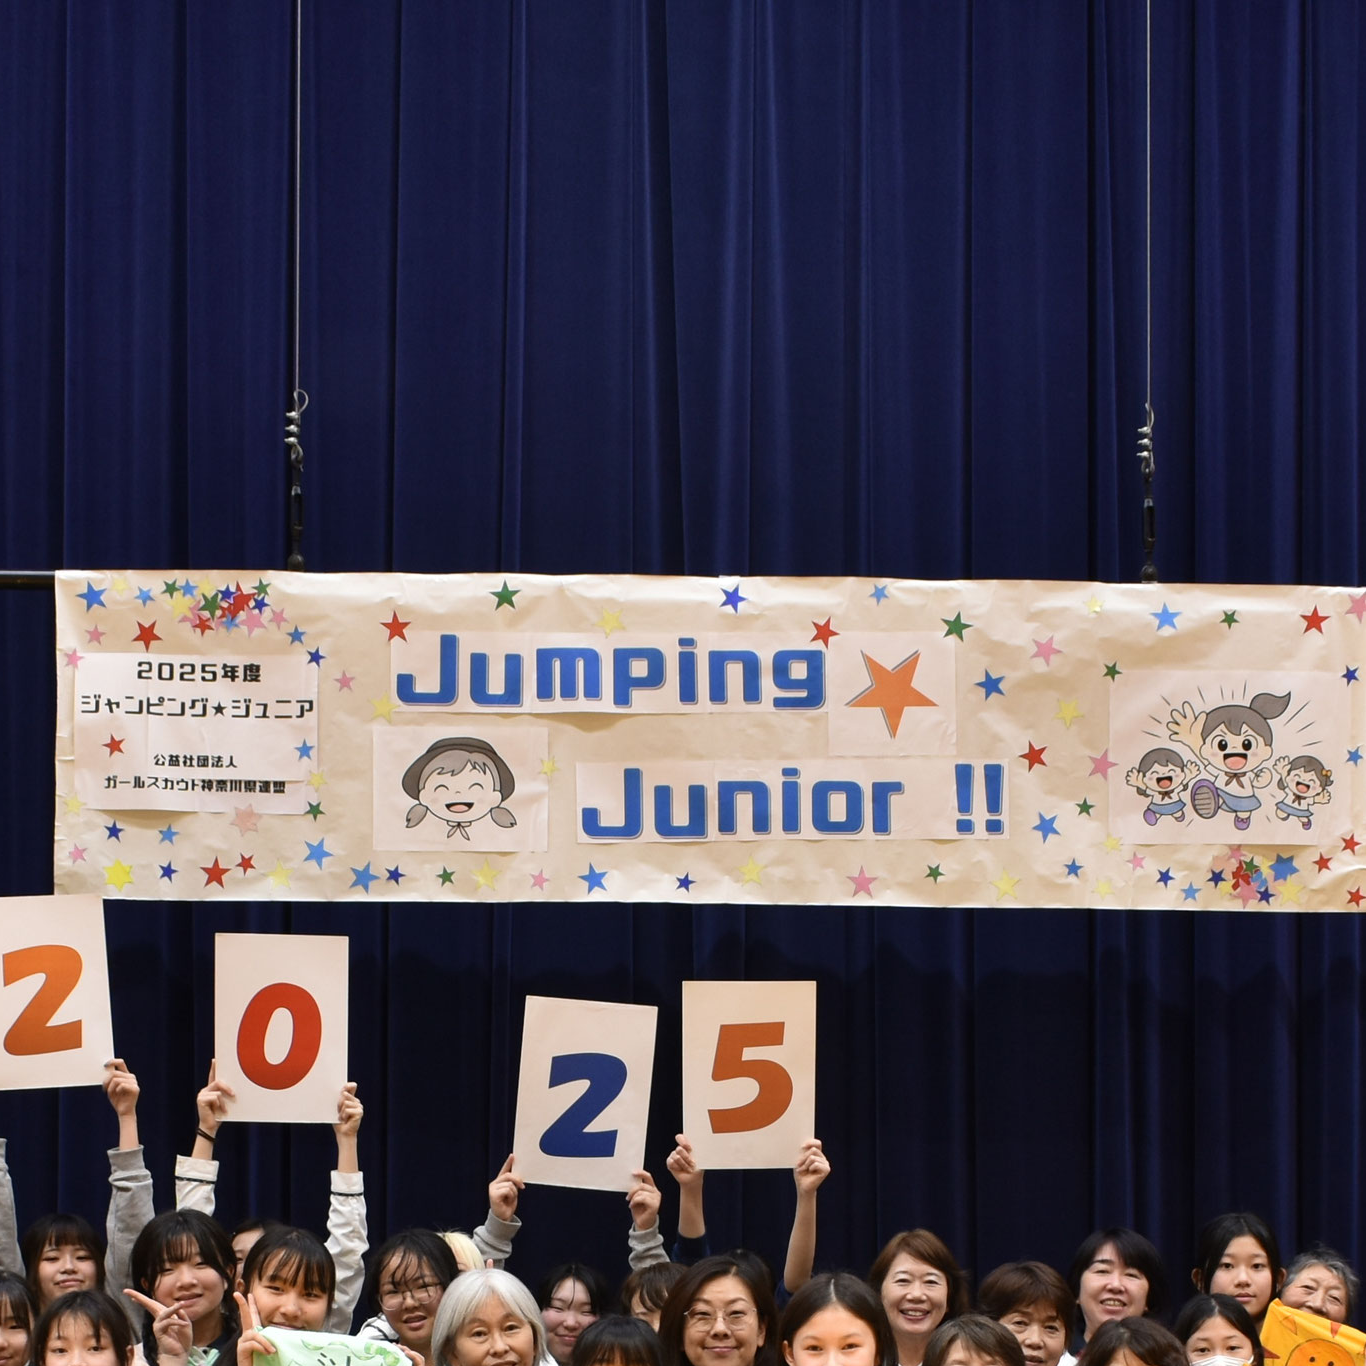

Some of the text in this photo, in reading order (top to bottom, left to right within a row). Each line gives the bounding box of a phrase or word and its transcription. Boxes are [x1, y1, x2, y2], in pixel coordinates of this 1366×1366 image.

[137, 661, 262, 683] 2025年度
[397, 634, 825, 708] Jumping
[153, 754, 238, 768] 公益社団法人
[104, 775, 287, 794] ガールスカウト神奈川県連盟
[582, 768, 904, 838] Junior
[3, 944, 794, 1158] 2 0 2 5
